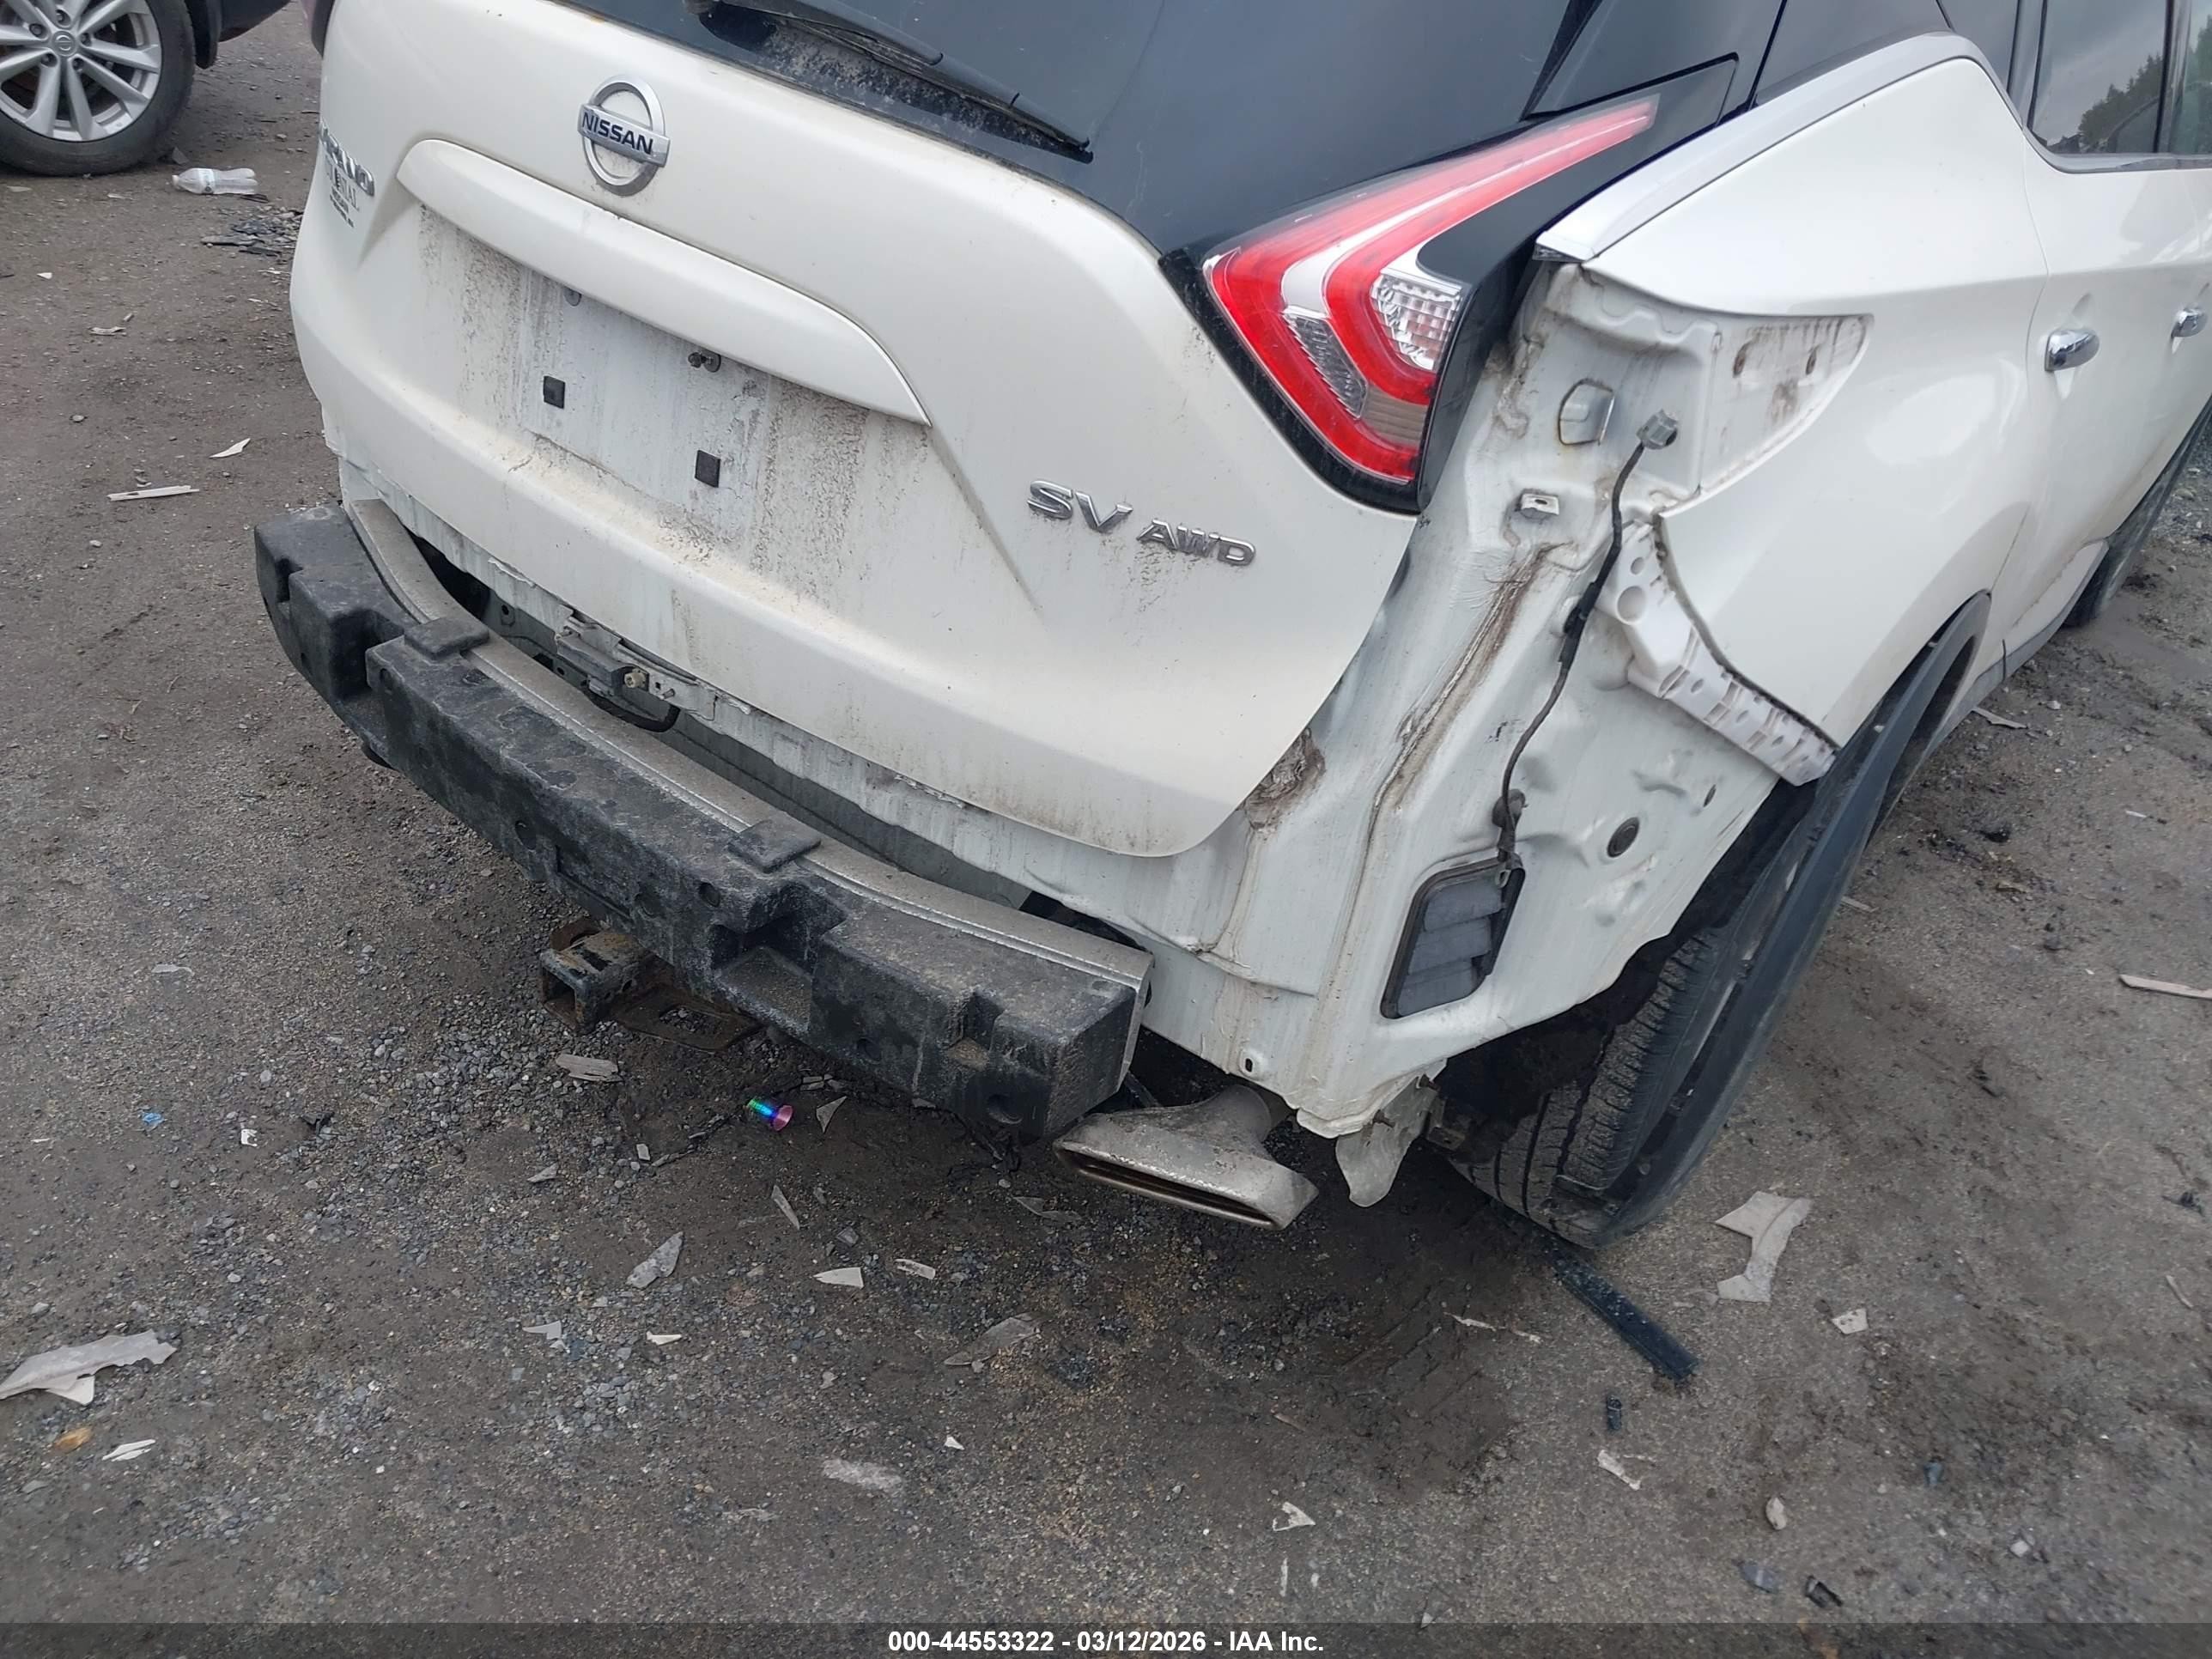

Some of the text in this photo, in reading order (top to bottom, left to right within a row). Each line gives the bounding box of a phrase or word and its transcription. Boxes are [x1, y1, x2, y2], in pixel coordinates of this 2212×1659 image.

[581, 111, 654, 155] NISSAN
[1026, 478, 1256, 567] SV AWD
